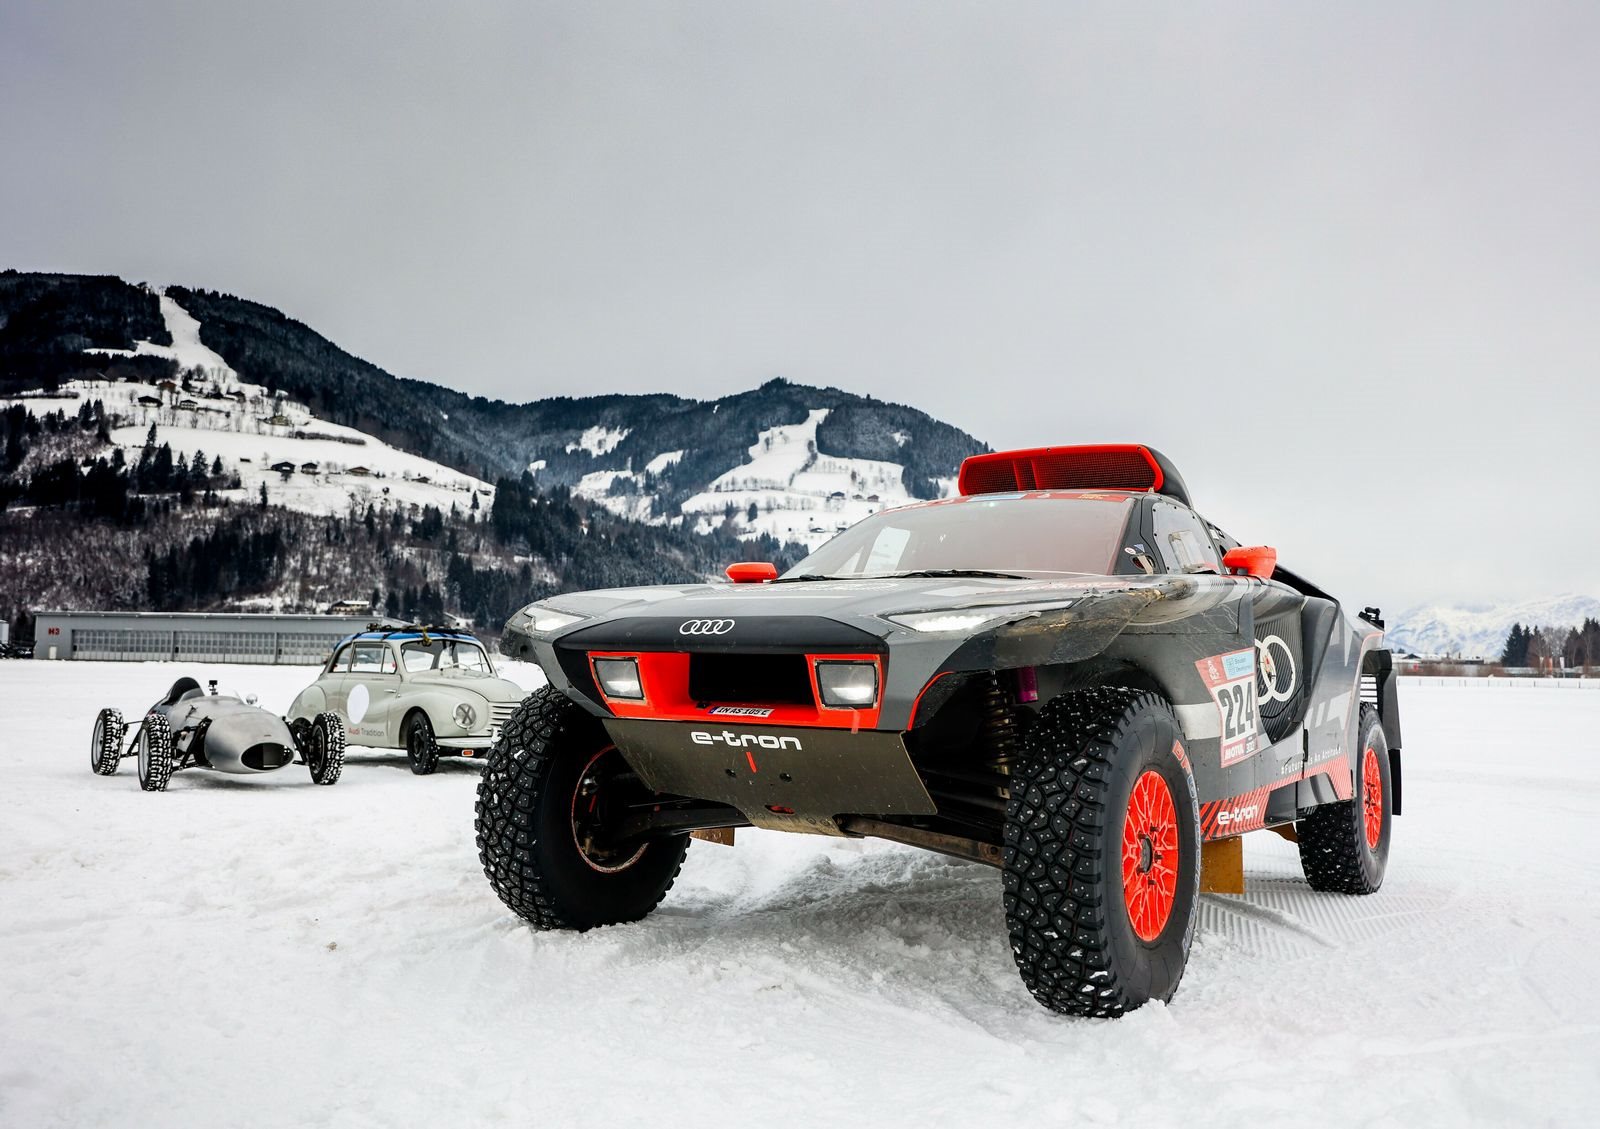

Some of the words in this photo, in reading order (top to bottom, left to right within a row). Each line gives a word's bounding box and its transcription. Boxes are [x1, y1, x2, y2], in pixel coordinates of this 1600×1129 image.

[1217, 681, 1254, 739] 224
[348, 727, 360, 735] Audi
[361, 728, 385, 737] Tradition
[691, 731, 802, 750] e-tron
[1217, 804, 1258, 825] e-tron
